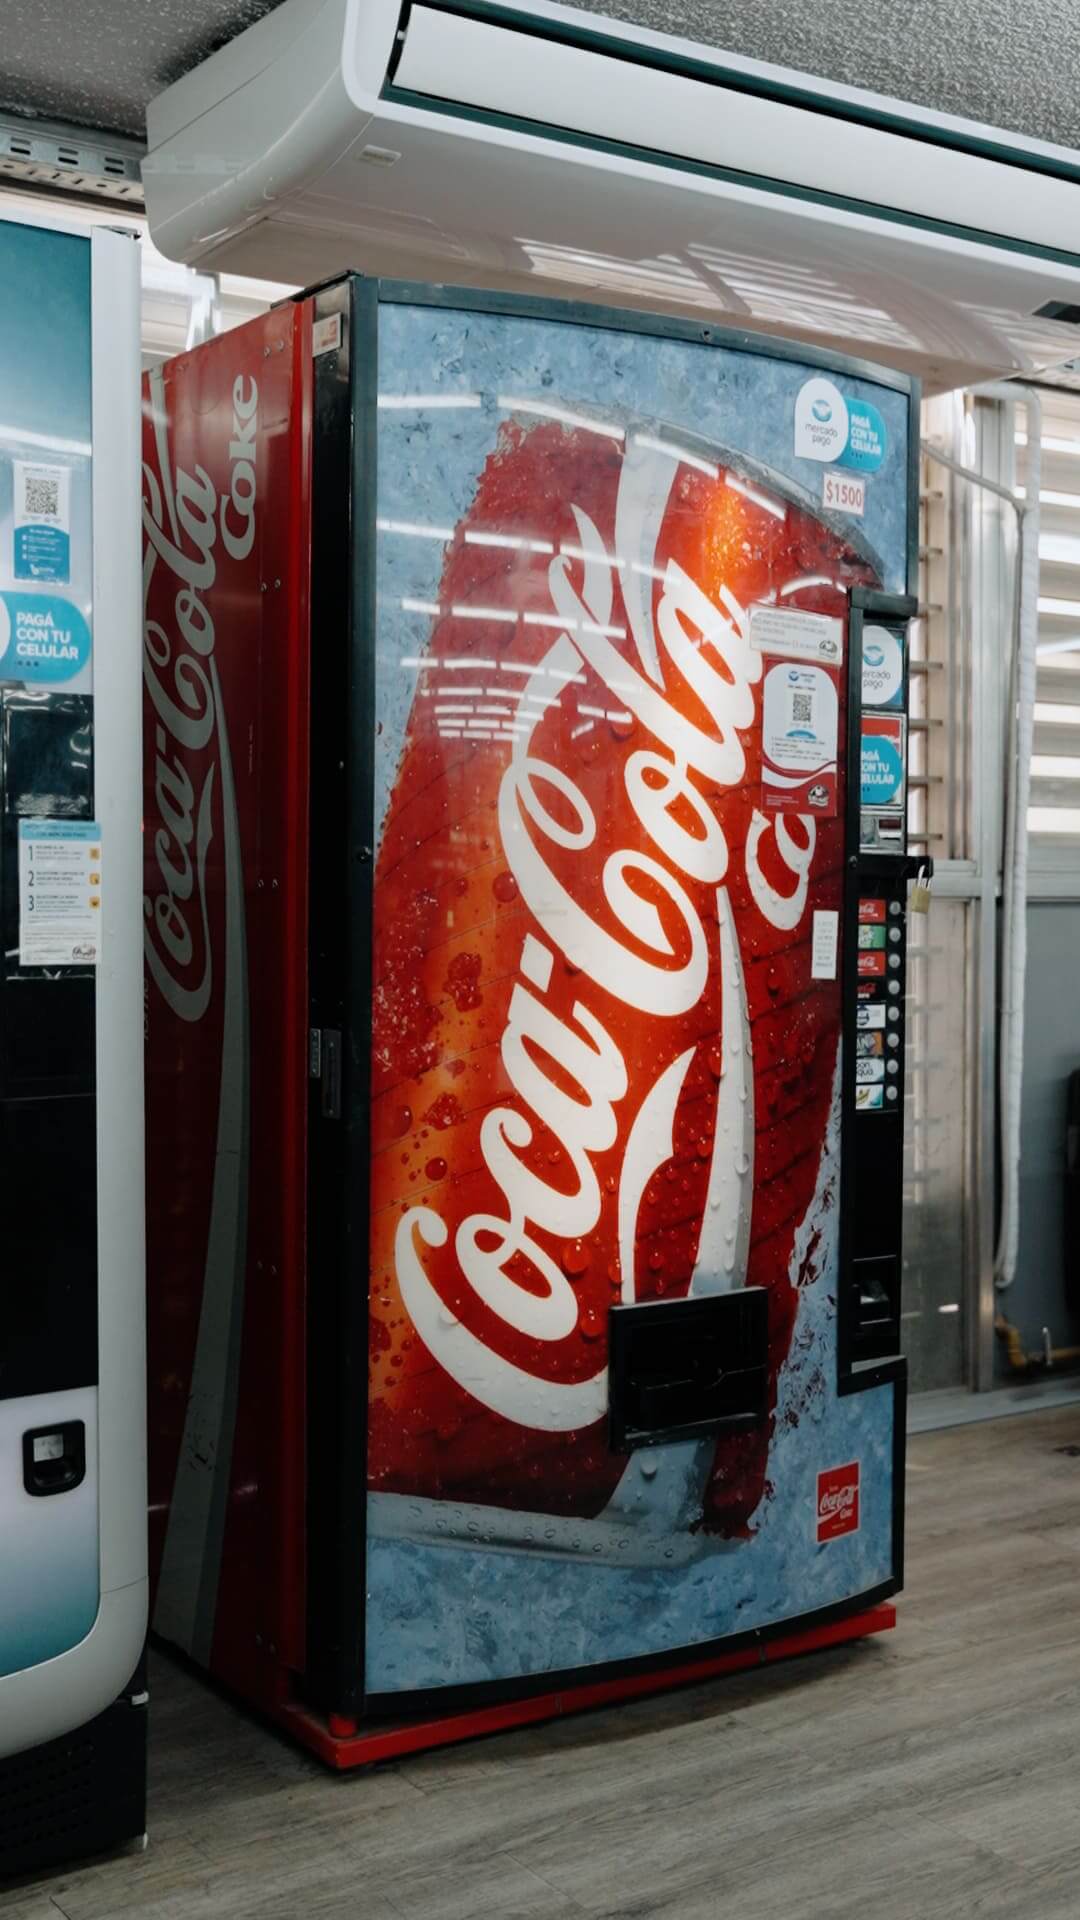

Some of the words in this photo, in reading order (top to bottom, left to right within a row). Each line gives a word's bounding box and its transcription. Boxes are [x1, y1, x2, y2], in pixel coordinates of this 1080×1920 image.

[805, 423, 838, 438] mercado
[811, 434, 832, 447] pago
[219, 374, 258, 561] Coke
[826, 479, 862, 507] $1500
[16, 609, 55, 627] PAGÁ
[16, 627, 49, 642] CON
[51, 629, 71, 644] TU
[16, 642, 79, 660] CELULAR
[862, 669, 891, 681] ercado
[863, 679, 883, 690] pago
[143, 460, 217, 1022] Coca-Cola
[861, 749, 880, 761] AGÁ
[861, 761, 876, 772] ON
[877, 762, 889, 773] TU
[861, 772, 895, 785] ELULAR
[28, 845, 33, 861] 1
[28, 870, 35, 887] 2
[28, 895, 35, 911] 3
[395, 503, 764, 1434] Coca-Cola
